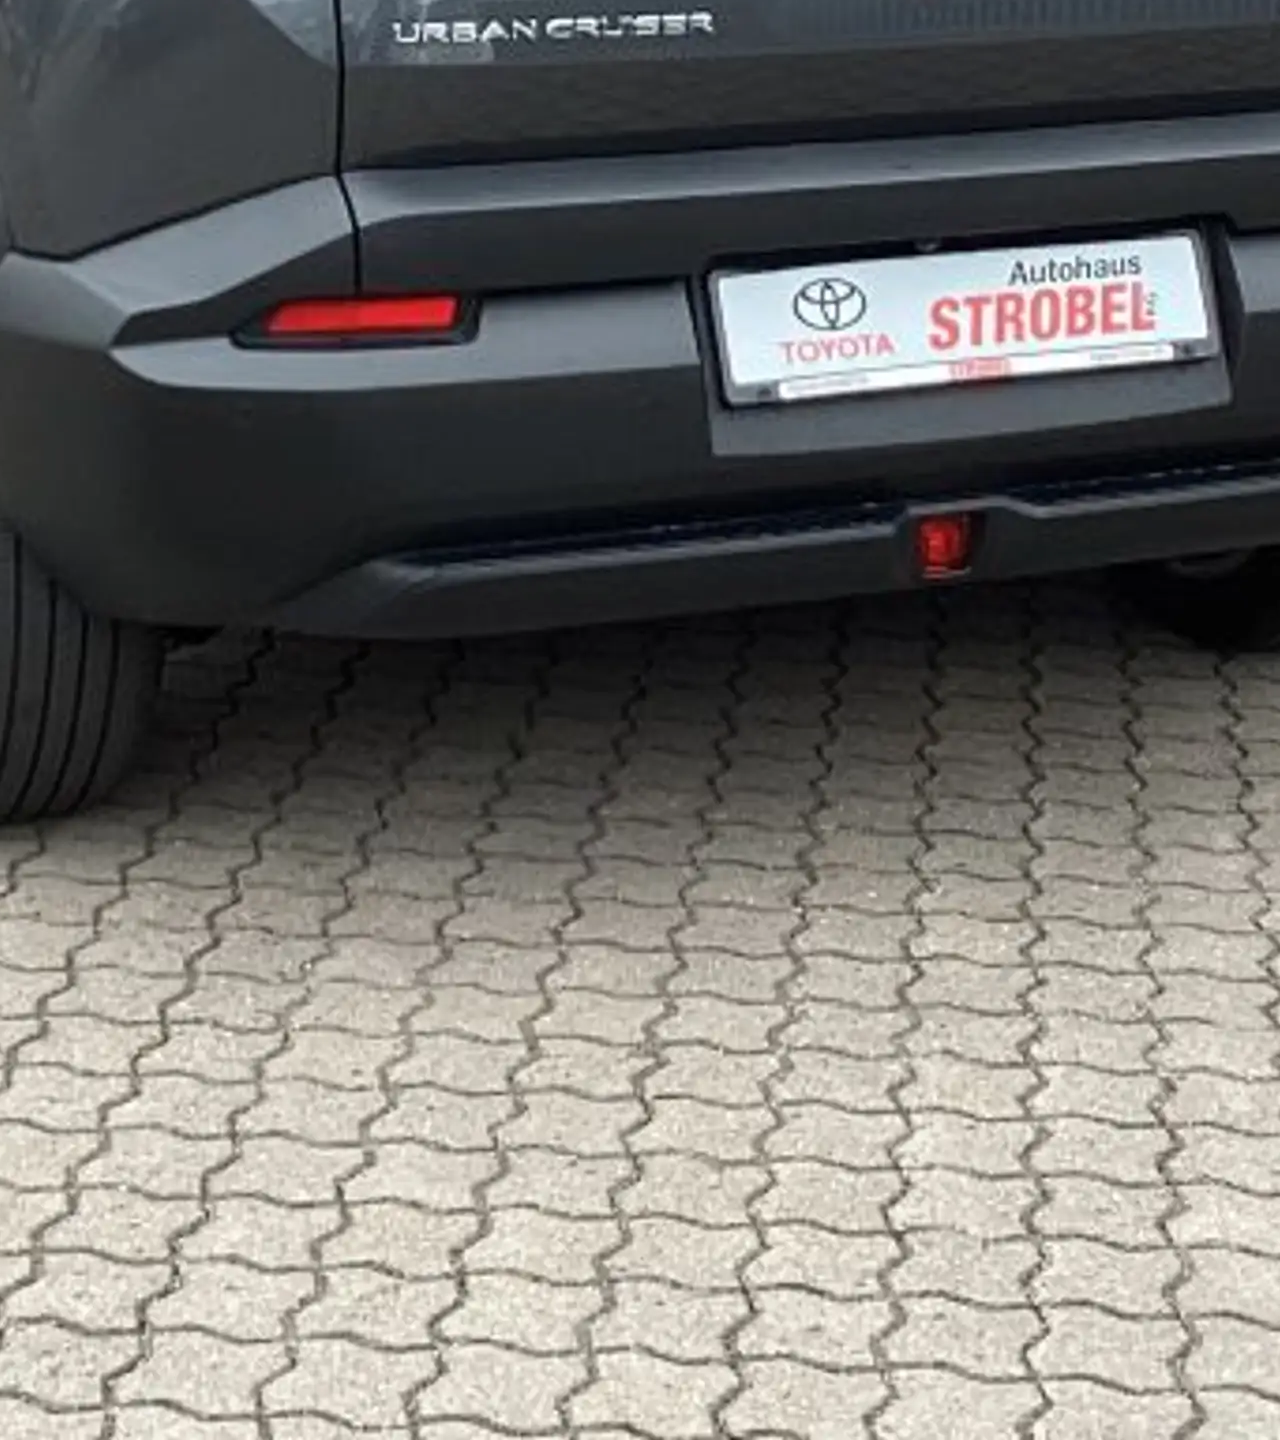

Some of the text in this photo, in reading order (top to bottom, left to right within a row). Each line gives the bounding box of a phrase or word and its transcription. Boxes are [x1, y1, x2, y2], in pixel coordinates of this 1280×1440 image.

[392, 18, 538, 44] URBAN
[1009, 253, 1142, 287] Autohaus
[928, 281, 1155, 352] STROBEL
[778, 331, 895, 365] TOYOTA
